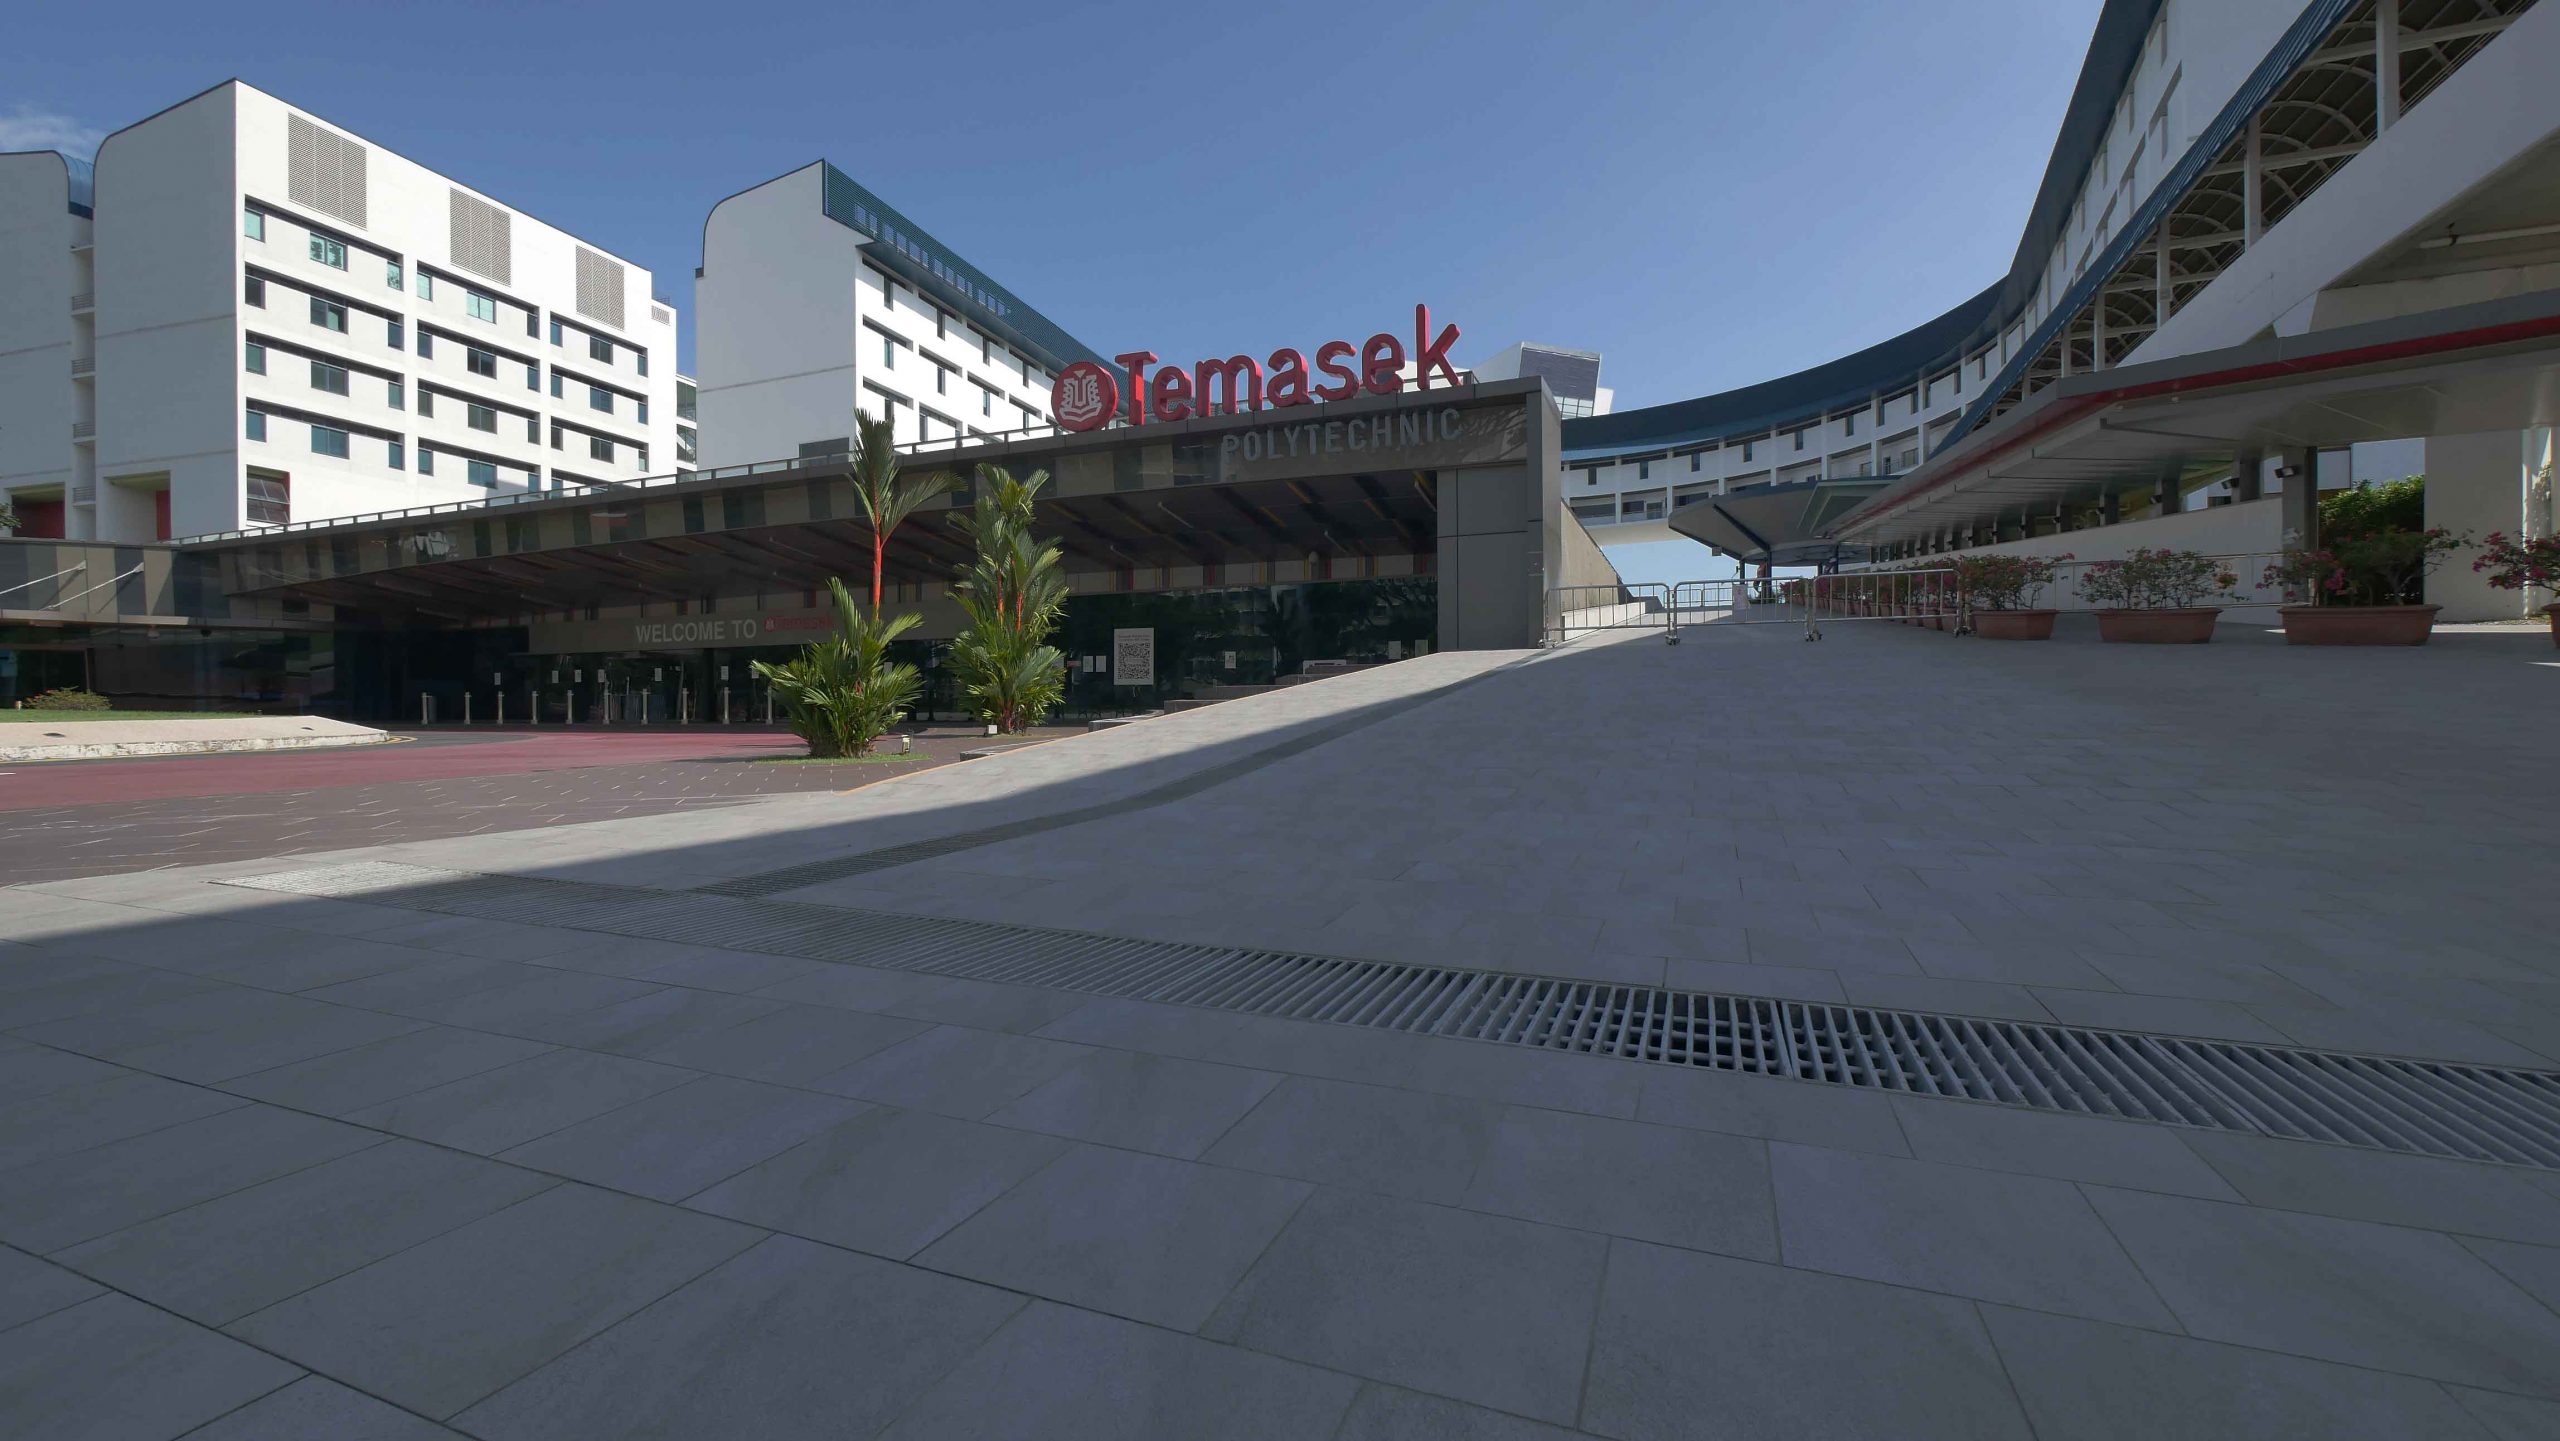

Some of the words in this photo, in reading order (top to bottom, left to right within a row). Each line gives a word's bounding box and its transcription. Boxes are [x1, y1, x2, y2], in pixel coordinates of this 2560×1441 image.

[1115, 303, 1461, 424] Temasek
[1221, 408, 1460, 461] POLYTECHNIC
[635, 621, 724, 643] WELCOME
[731, 619, 757, 639] TO
